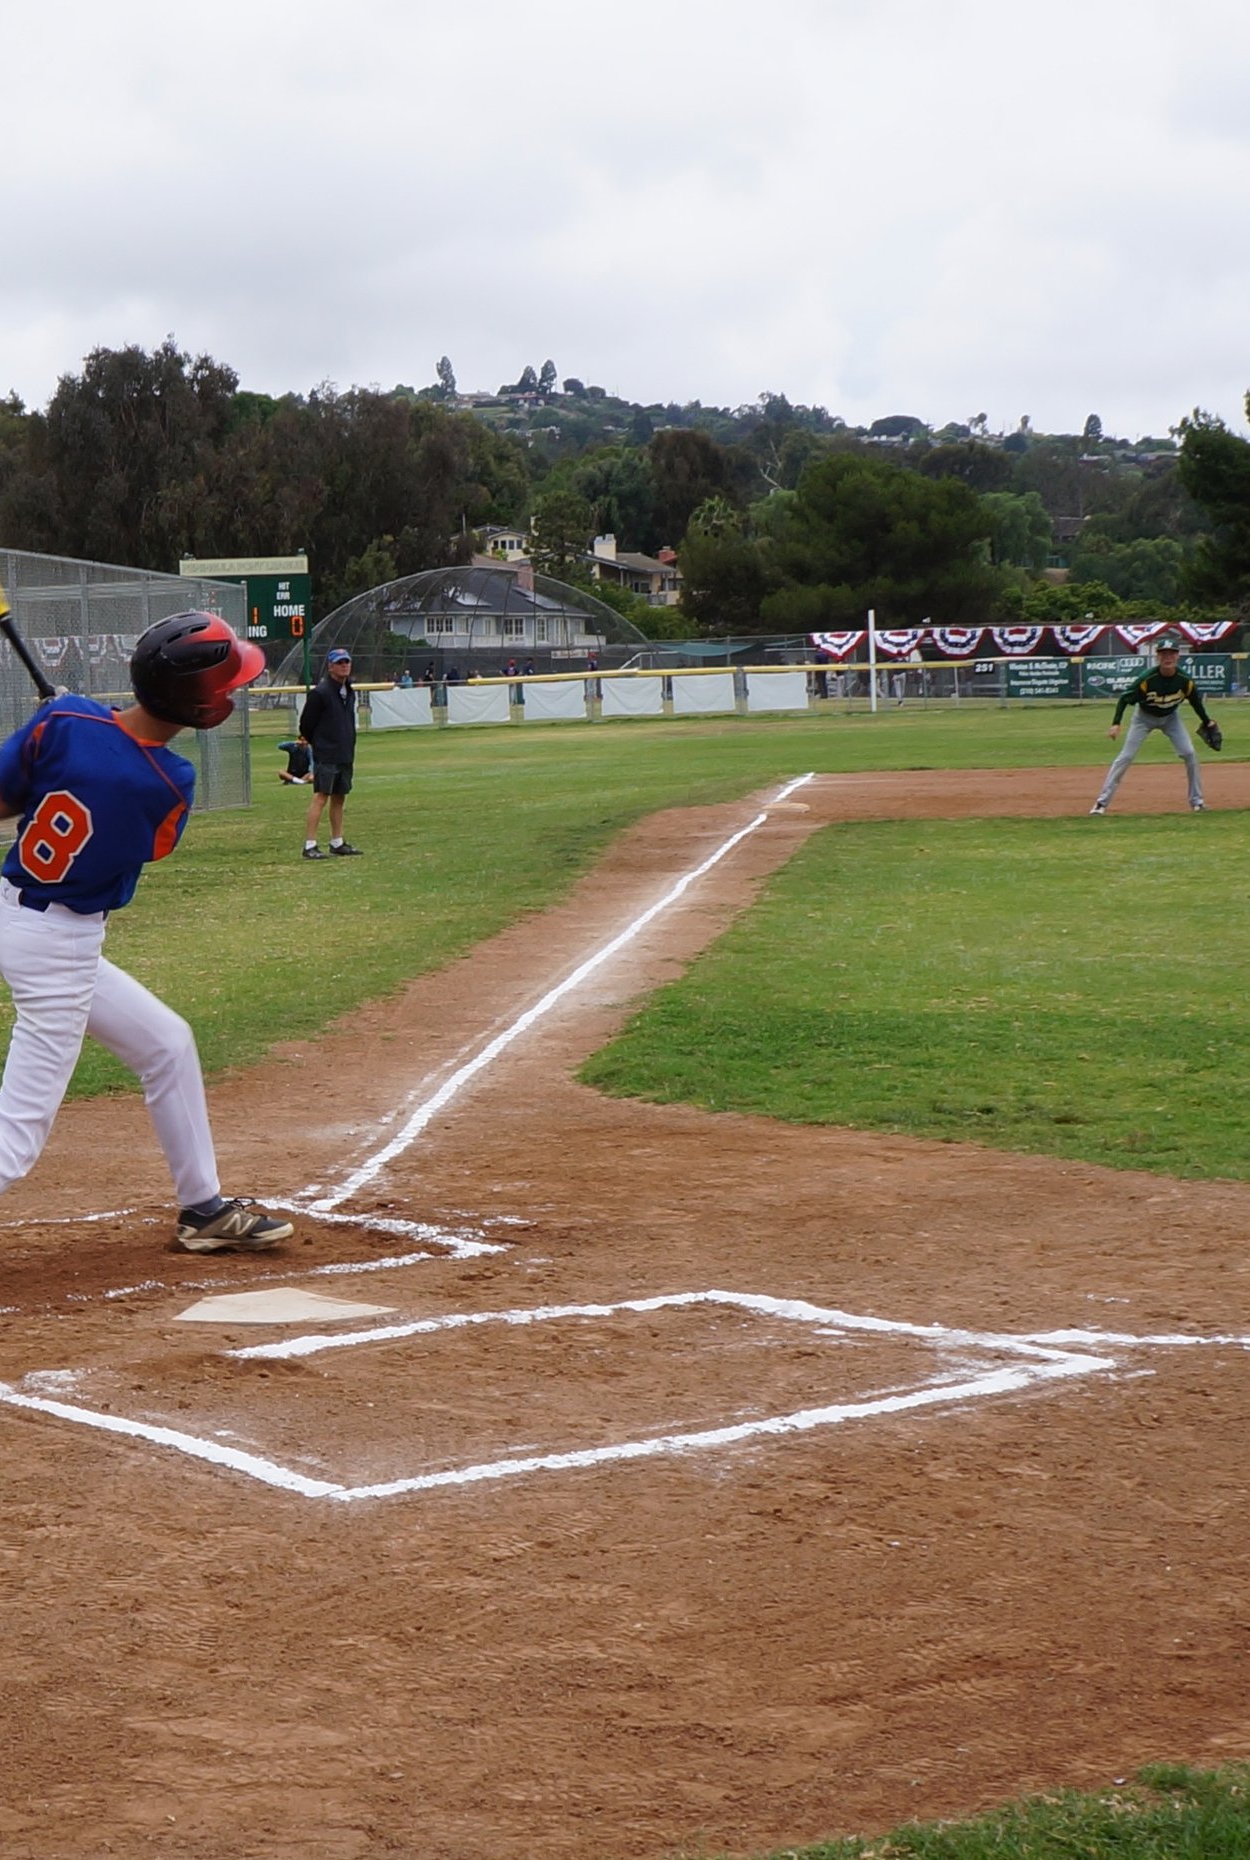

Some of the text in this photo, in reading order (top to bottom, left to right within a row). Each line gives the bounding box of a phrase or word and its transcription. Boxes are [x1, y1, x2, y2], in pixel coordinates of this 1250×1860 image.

[278, 582, 290, 591] HIT
[273, 605, 305, 617] HOME
[291, 616, 304, 636] 0
[975, 663, 993, 673] 251
[1087, 662, 1116, 670] PACIFIC
[18, 790, 94, 883] 8
